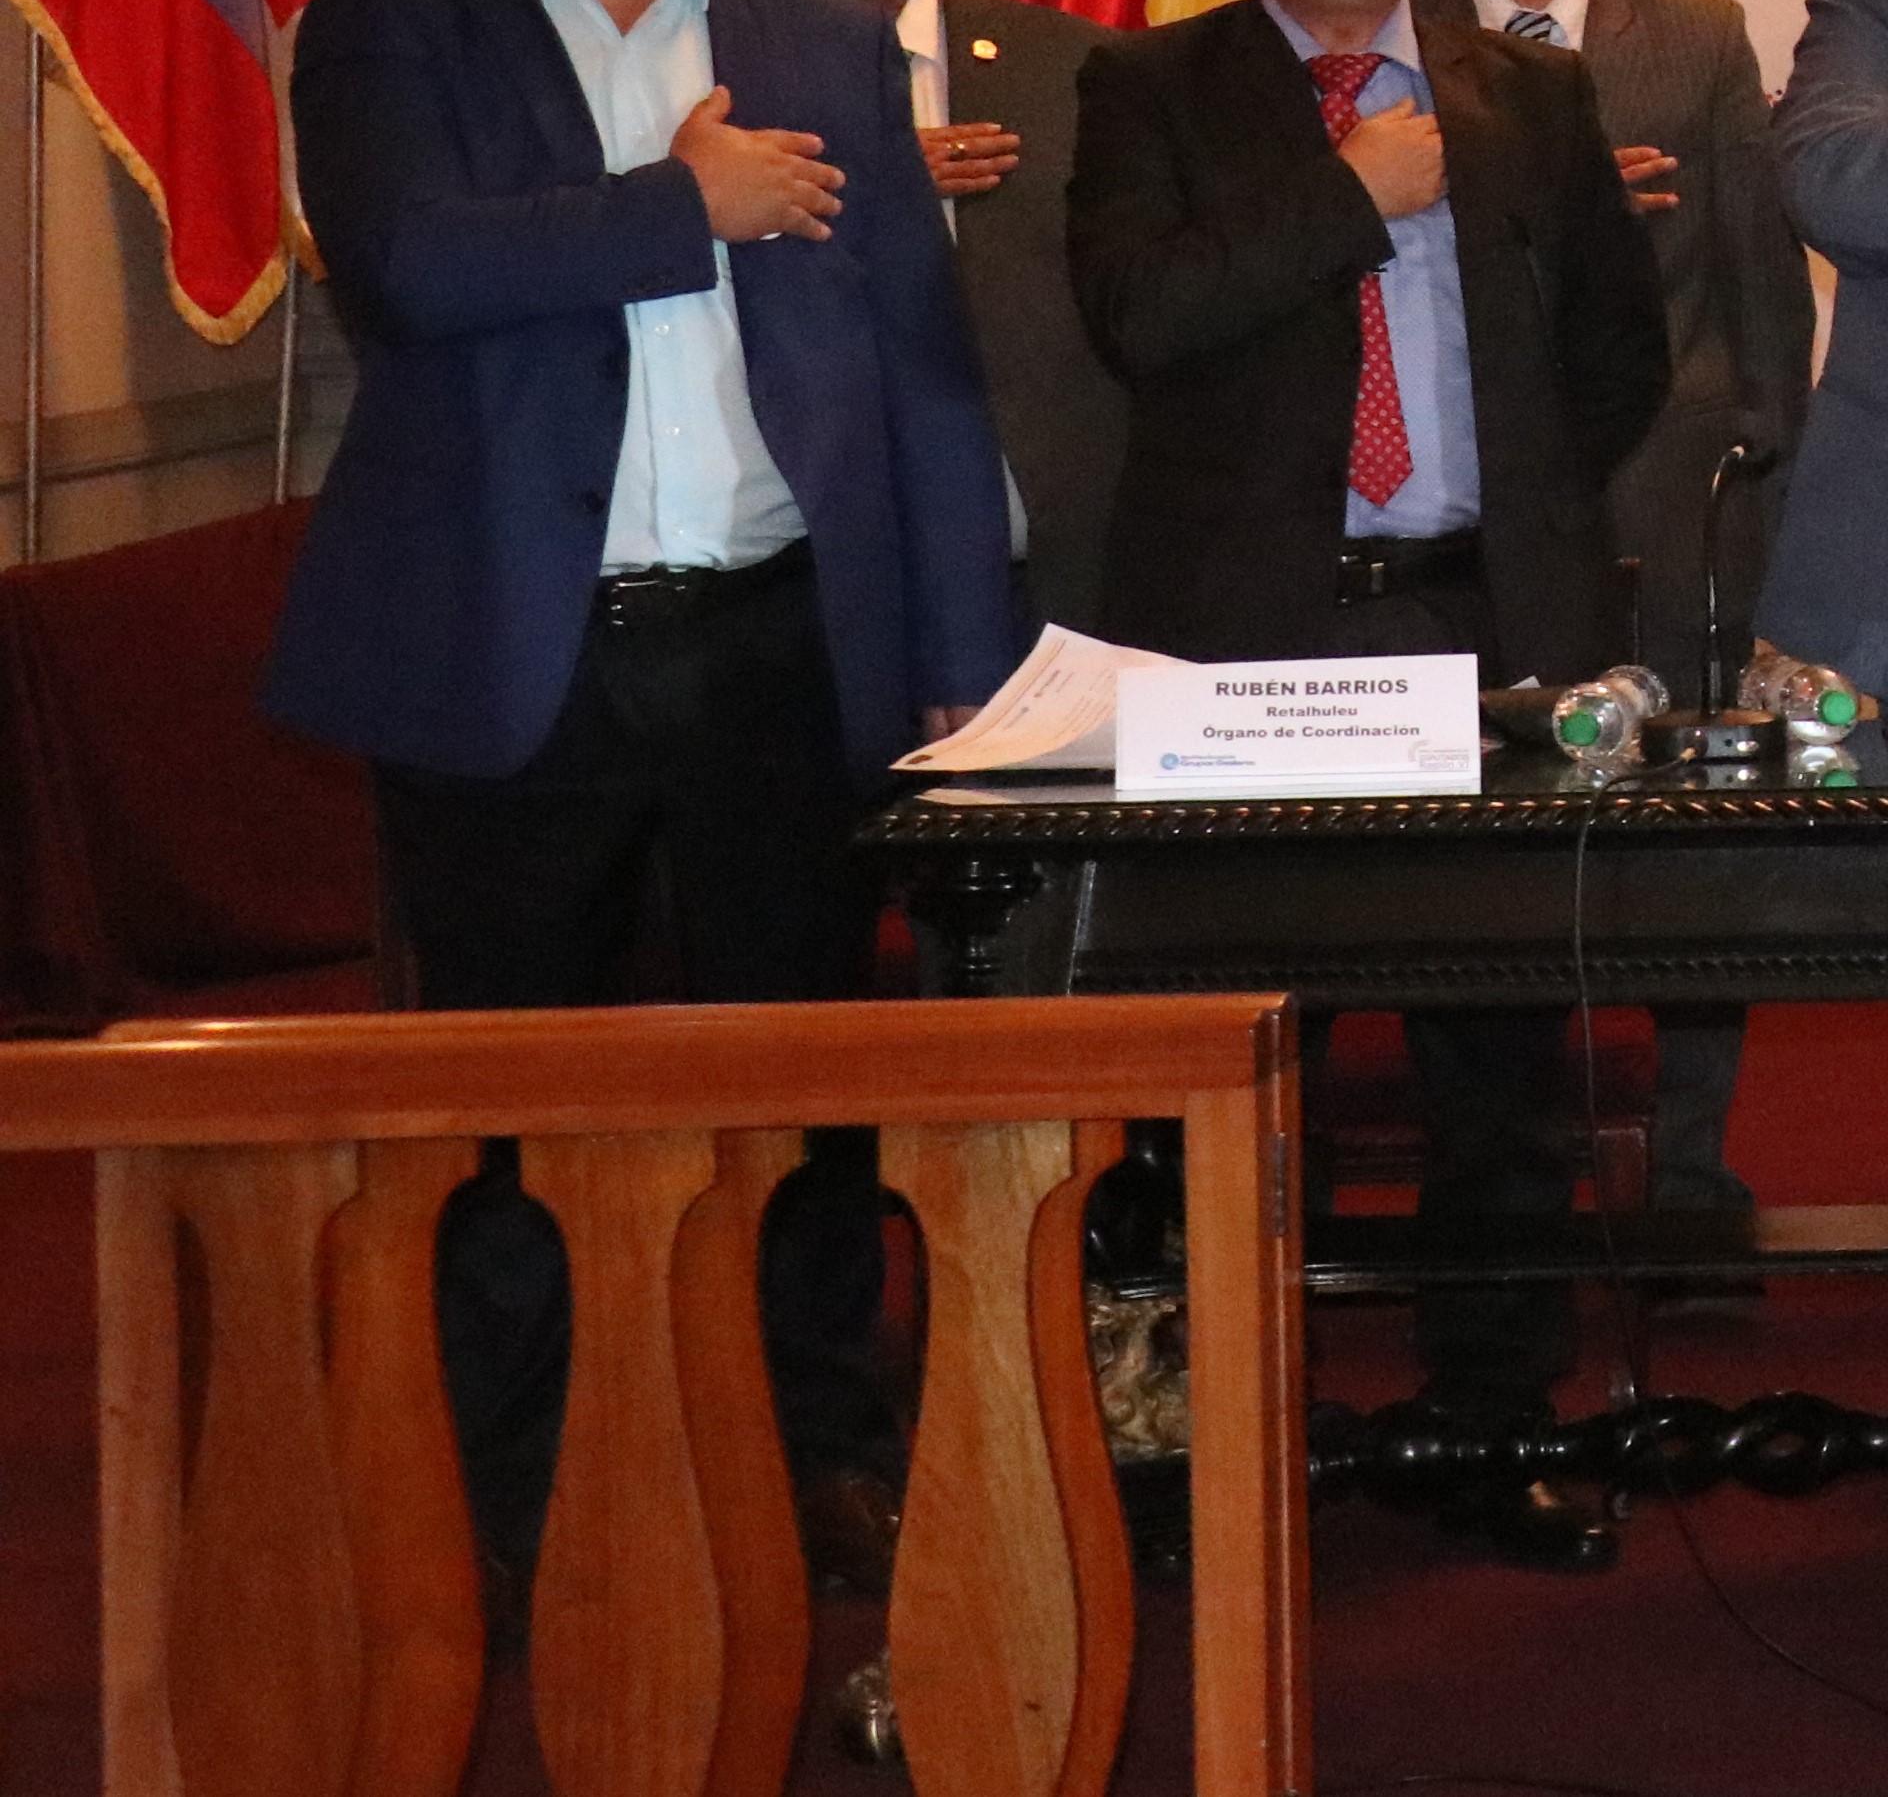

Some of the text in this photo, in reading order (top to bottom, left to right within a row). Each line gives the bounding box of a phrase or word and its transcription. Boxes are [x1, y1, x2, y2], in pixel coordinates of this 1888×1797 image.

[1214, 677, 1409, 697] RUBÉN BARRIOS
[1265, 705, 1359, 719] Retalhuleu
[1202, 722, 1421, 742] Órgano de Coordinación
